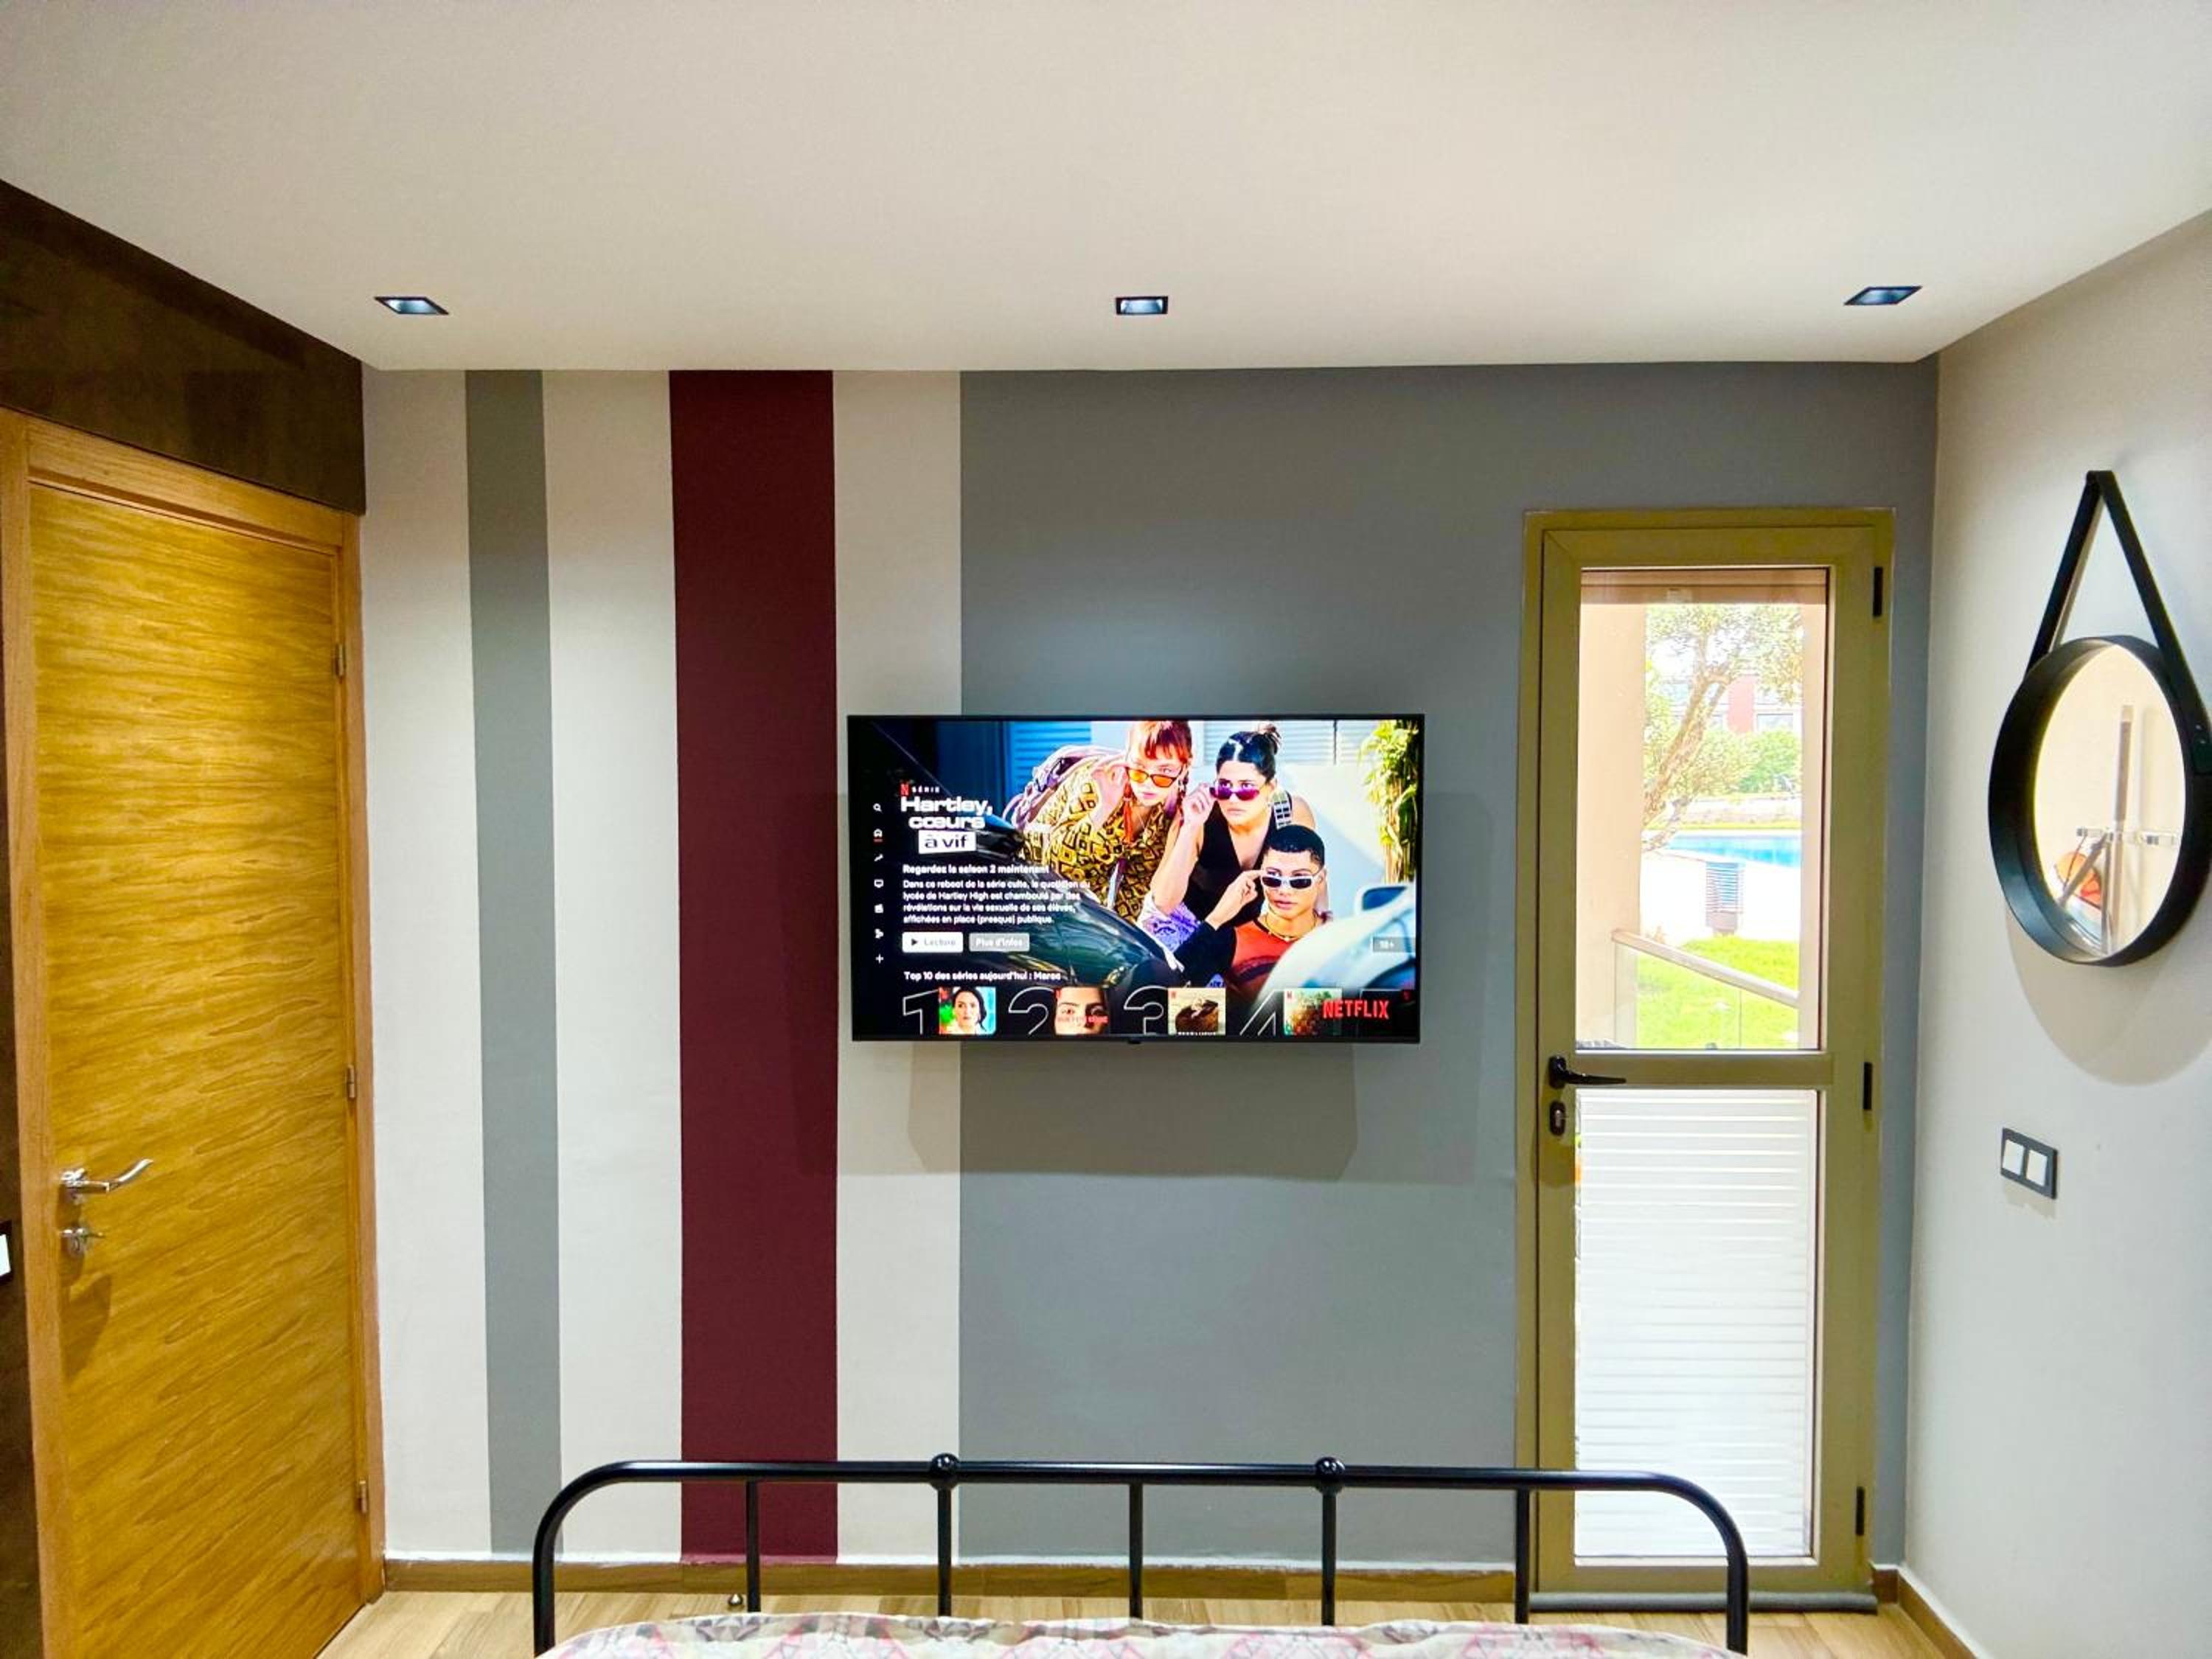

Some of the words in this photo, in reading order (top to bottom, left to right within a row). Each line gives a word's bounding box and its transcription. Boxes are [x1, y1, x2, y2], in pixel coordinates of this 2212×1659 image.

[900, 796, 992, 815] Hartley,
[942, 834, 967, 848] vif
[902, 864, 947, 876] Regardez
[948, 864, 957, 874] la
[959, 864, 988, 874] saison
[990, 864, 996, 874] 2
[998, 864, 1049, 874] maintenant
[903, 880, 924, 888] Dans
[937, 880, 964, 888] reboot
[965, 880, 976, 888] de
[978, 880, 985, 888] la
[987, 880, 1006, 888] série
[1007, 880, 1029, 889] culte,
[1032, 880, 1039, 888] le
[902, 891, 925, 902] lycée
[926, 891, 937, 900] de
[939, 891, 968, 902] Hartley
[970, 891, 989, 902] High
[990, 892, 1003, 900] est
[1004, 891, 1049, 900] chamboulé
[903, 903, 947, 912] révélations
[963, 903, 971, 912] la
[972, 903, 984, 912] vie
[985, 903, 1018, 912] sexuelle
[1020, 903, 1031, 912] de
[903, 914, 940, 924] affichées
[953, 914, 975, 925] place
[977, 914, 1015, 925] (presque)
[1018, 914, 1054, 925] publique.
[924, 936, 956, 947] Lecture
[975, 937, 993, 947] Plus
[904, 971, 922, 981] Top
[923, 971, 933, 981] 10
[934, 971, 950, 981] des
[952, 971, 978, 981] séries
[979, 971, 1028, 982] aujourd'hui
[1034, 971, 1062, 981] Maroc
[1321, 999, 1390, 1020] NETFLIX
